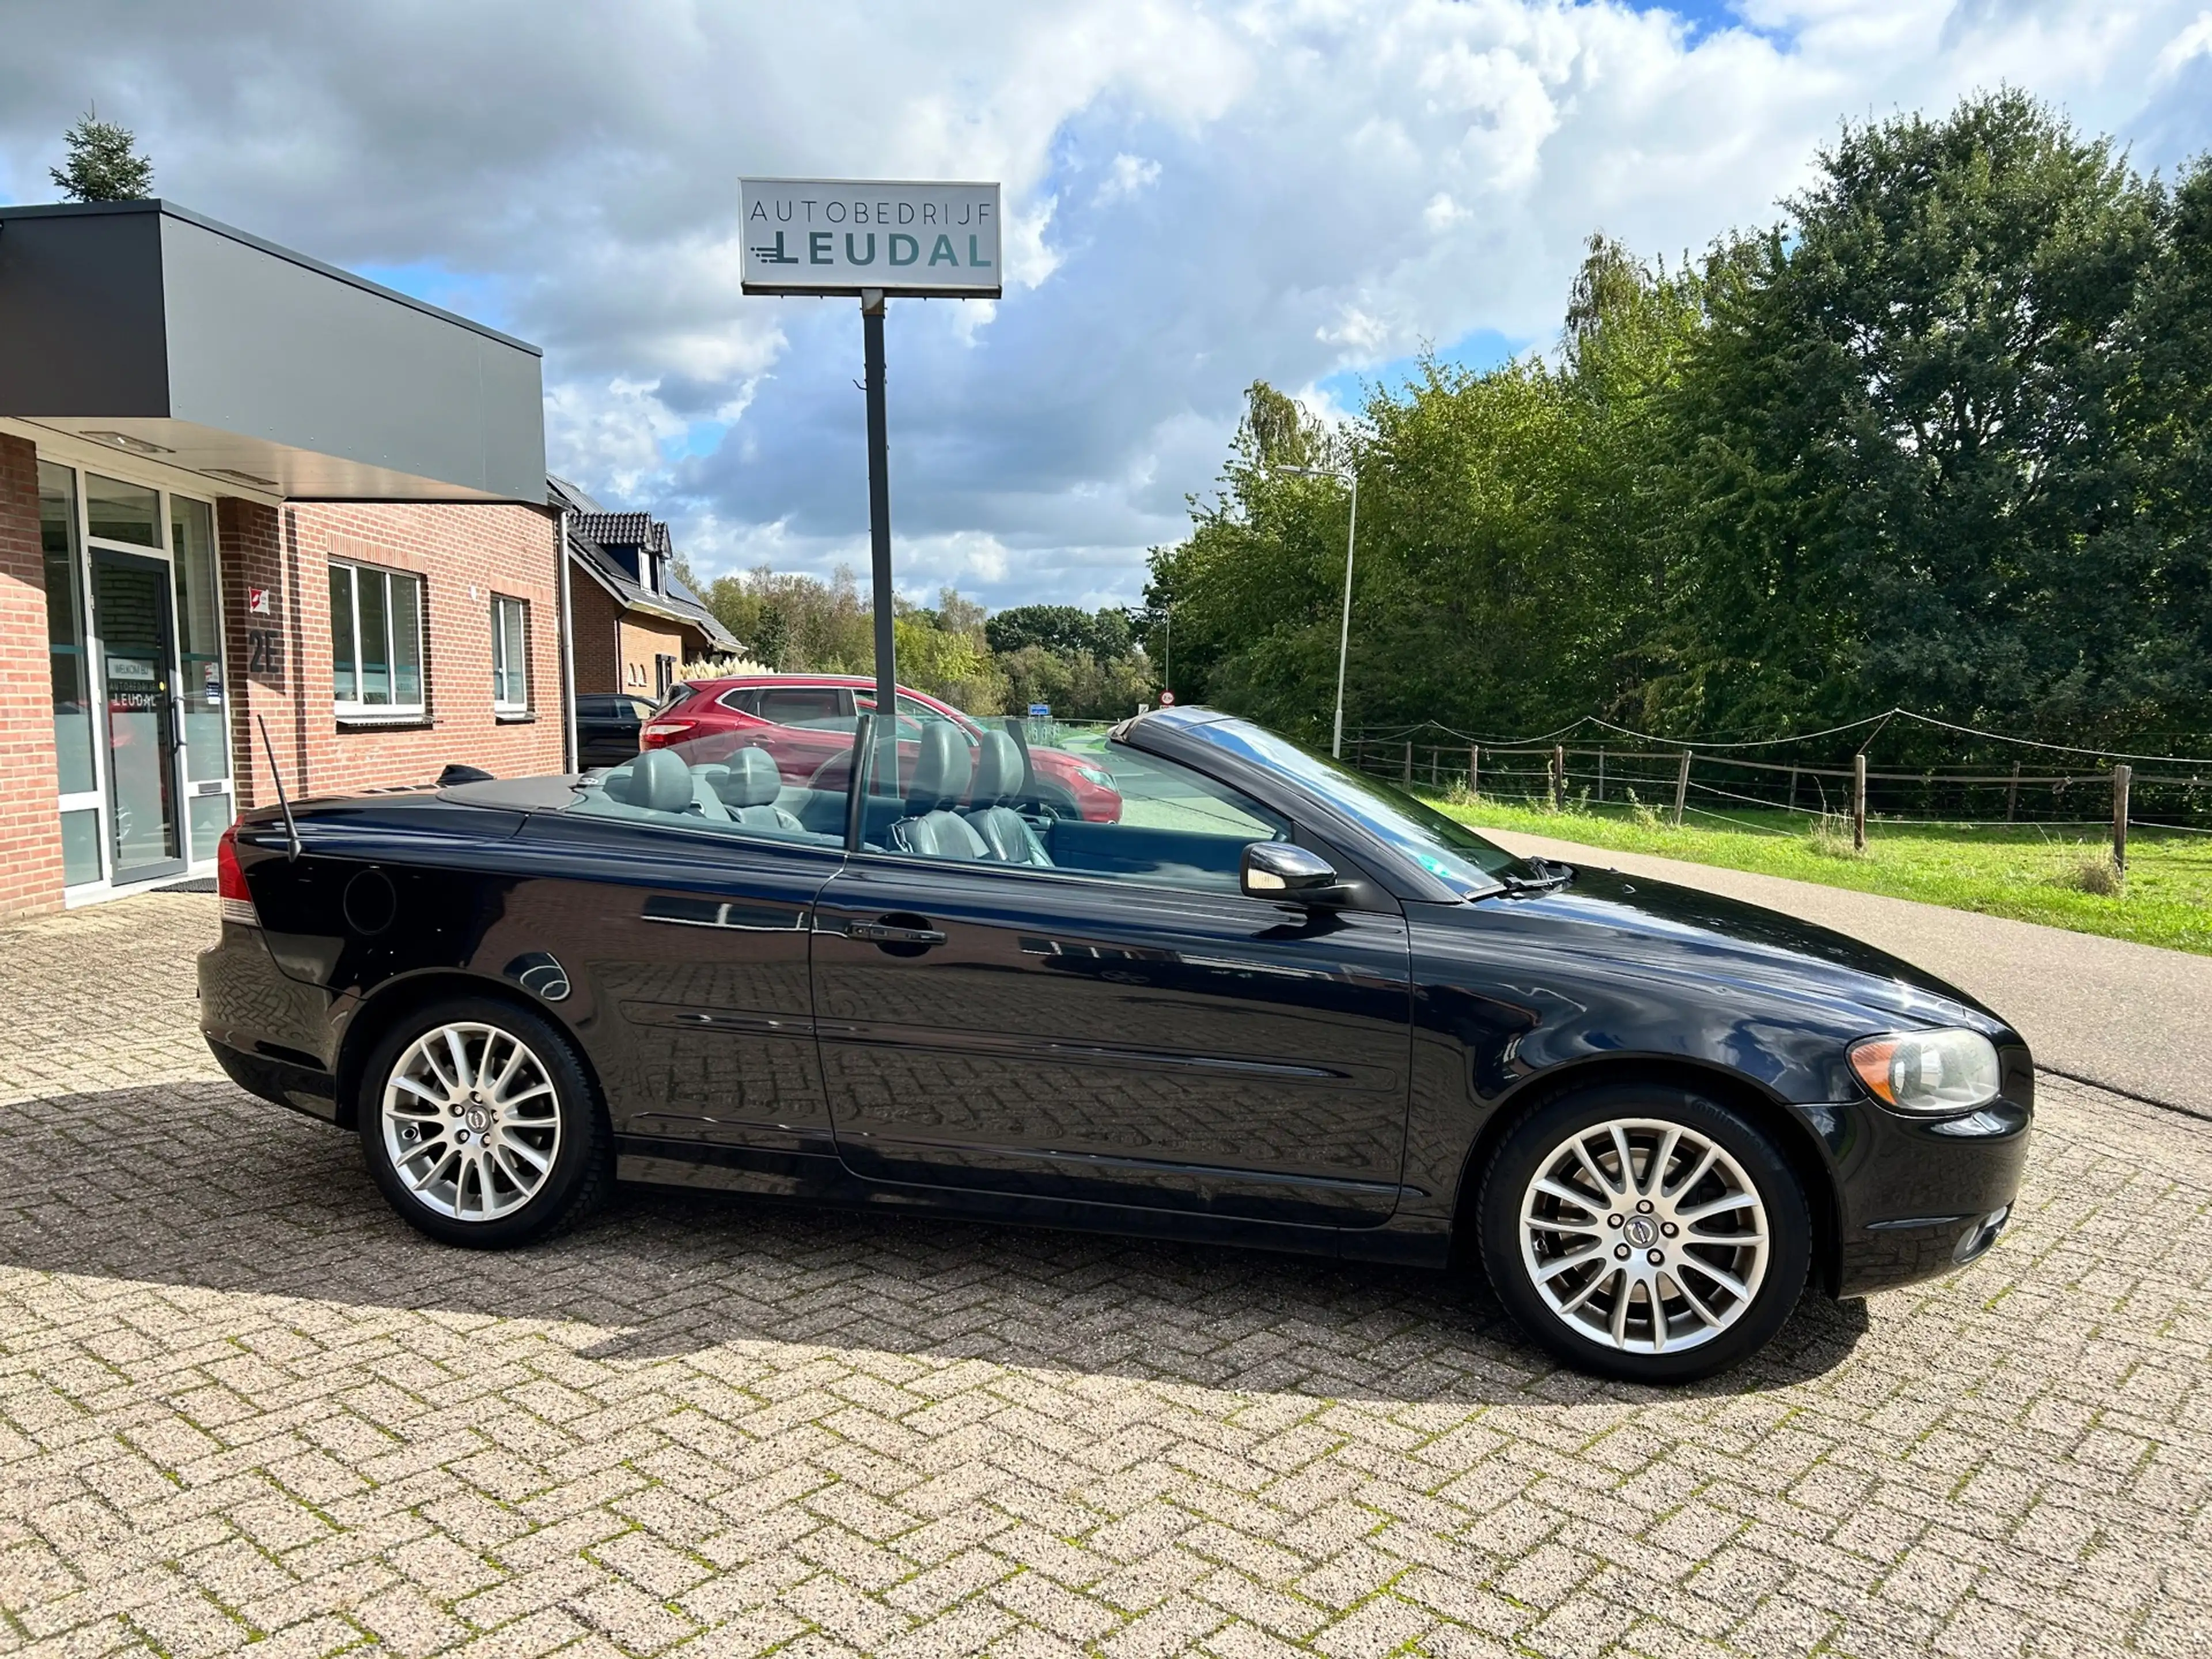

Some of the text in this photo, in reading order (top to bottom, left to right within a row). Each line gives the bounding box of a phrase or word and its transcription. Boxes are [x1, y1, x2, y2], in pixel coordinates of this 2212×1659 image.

[751, 200, 991, 225] AUTOBEDRIJF
[759, 231, 992, 267] LEUDAL
[249, 630, 279, 673] 2E
[112, 693, 157, 706] LEUDAL
